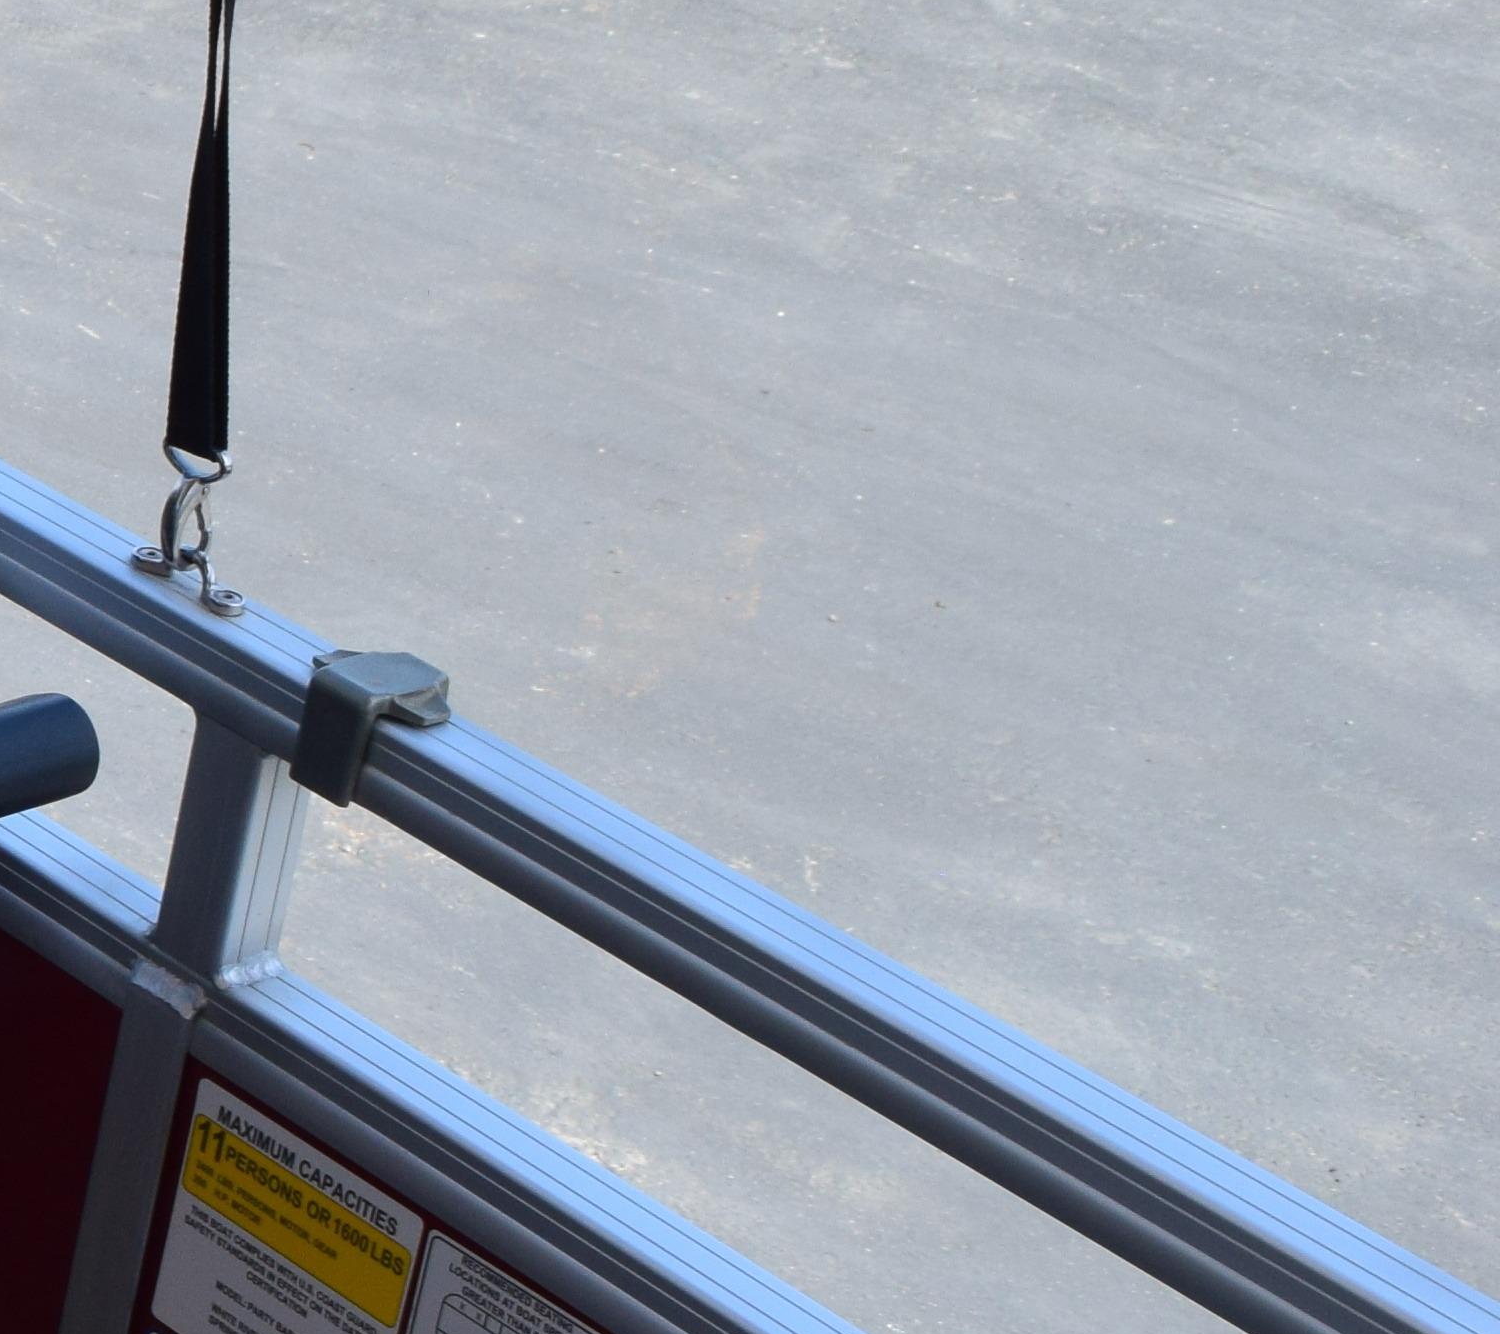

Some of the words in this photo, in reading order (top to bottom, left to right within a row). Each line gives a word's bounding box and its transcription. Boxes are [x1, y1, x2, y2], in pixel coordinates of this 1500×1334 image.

[197, 1119, 226, 1164] 11
[225, 1146, 302, 1209] PERSONS
[306, 1199, 330, 1228] OR
[333, 1217, 369, 1253] 1600
[370, 1242, 404, 1276] LBS
[218, 1107, 295, 1169] MAXIMUM
[298, 1159, 397, 1236] CAPACITIES
[185, 1215, 214, 1241] SAFETY
[217, 1237, 265, 1275] STANDARDS
[267, 1271, 274, 1282] IN
[277, 1278, 307, 1304] EFFECT
[309, 1299, 321, 1314] ON
[324, 1310, 339, 1326] THE
[191, 1206, 208, 1223] THIS
[210, 1219, 233, 1240] BOAT
[234, 1235, 274, 1268] COMPLIES
[277, 1264, 297, 1284] WITH
[299, 1279, 313, 1294] U.S.
[316, 1290, 344, 1315] COAST
[246, 1271, 307, 1317] CERTIFICATION
[449, 1263, 499, 1301] LOCATIONS
[502, 1297, 513, 1310] AT
[516, 1306, 541, 1327] BOAT
[461, 1257, 531, 1306] RECOMMENDED
[534, 1302, 573, 1332] SEATING
[211, 1304, 235, 1326] WHITE
[247, 1302, 273, 1327] PARTY
[462, 1286, 504, 1318] GREATER
[508, 1315, 531, 1334] THAN
